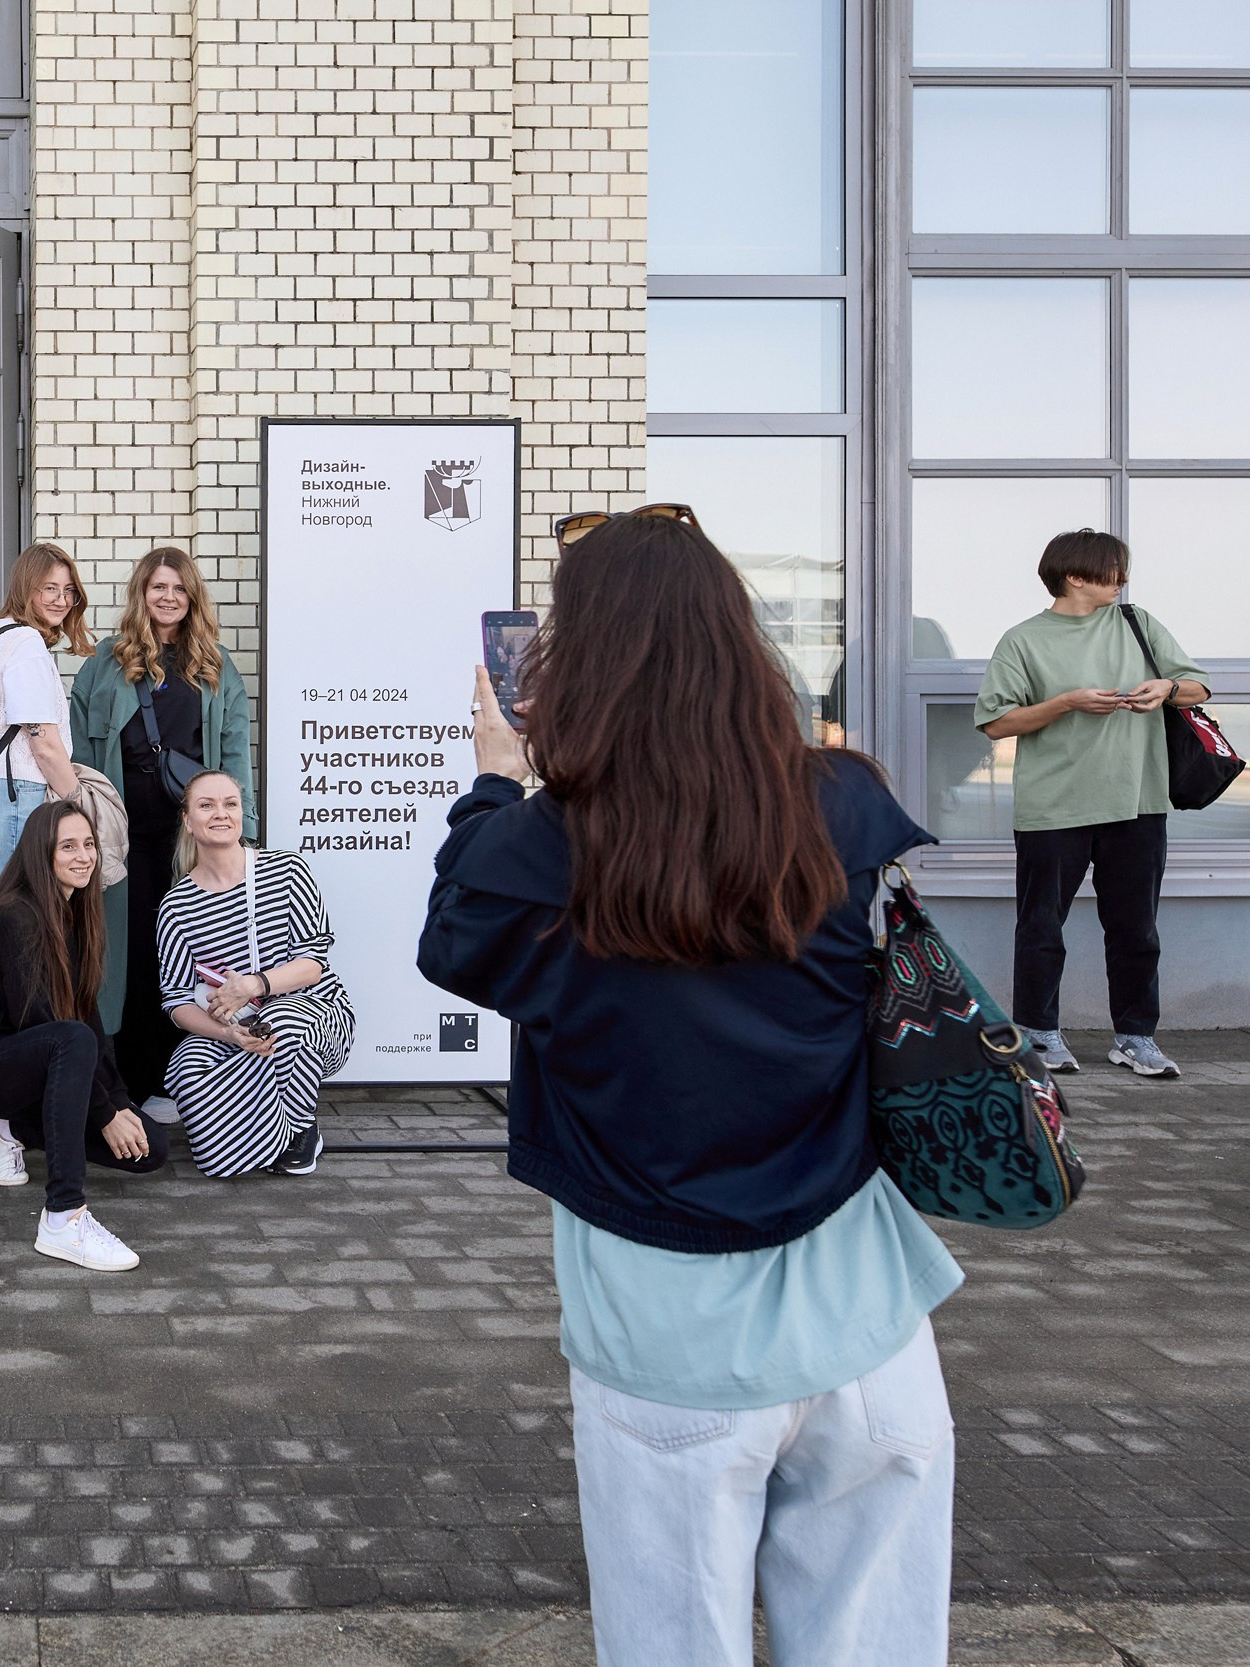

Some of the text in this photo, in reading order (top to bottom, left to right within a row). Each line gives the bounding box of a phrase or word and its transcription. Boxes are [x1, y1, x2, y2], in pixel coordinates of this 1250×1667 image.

[301, 459, 366, 476] Дизайн-
[301, 480, 391, 493] выходные.
[301, 494, 360, 508] Нижний
[301, 512, 373, 529] Новгород
[301, 688, 409, 702] 19–21 04 2024
[301, 720, 475, 745] Приветствуем
[300, 752, 445, 773] участников
[300, 775, 460, 799] 44-го съезда
[299, 802, 417, 827] деятелей
[299, 830, 411, 854] дизайна!
[413, 1033, 432, 1042] при
[375, 1045, 432, 1054] поддержке
